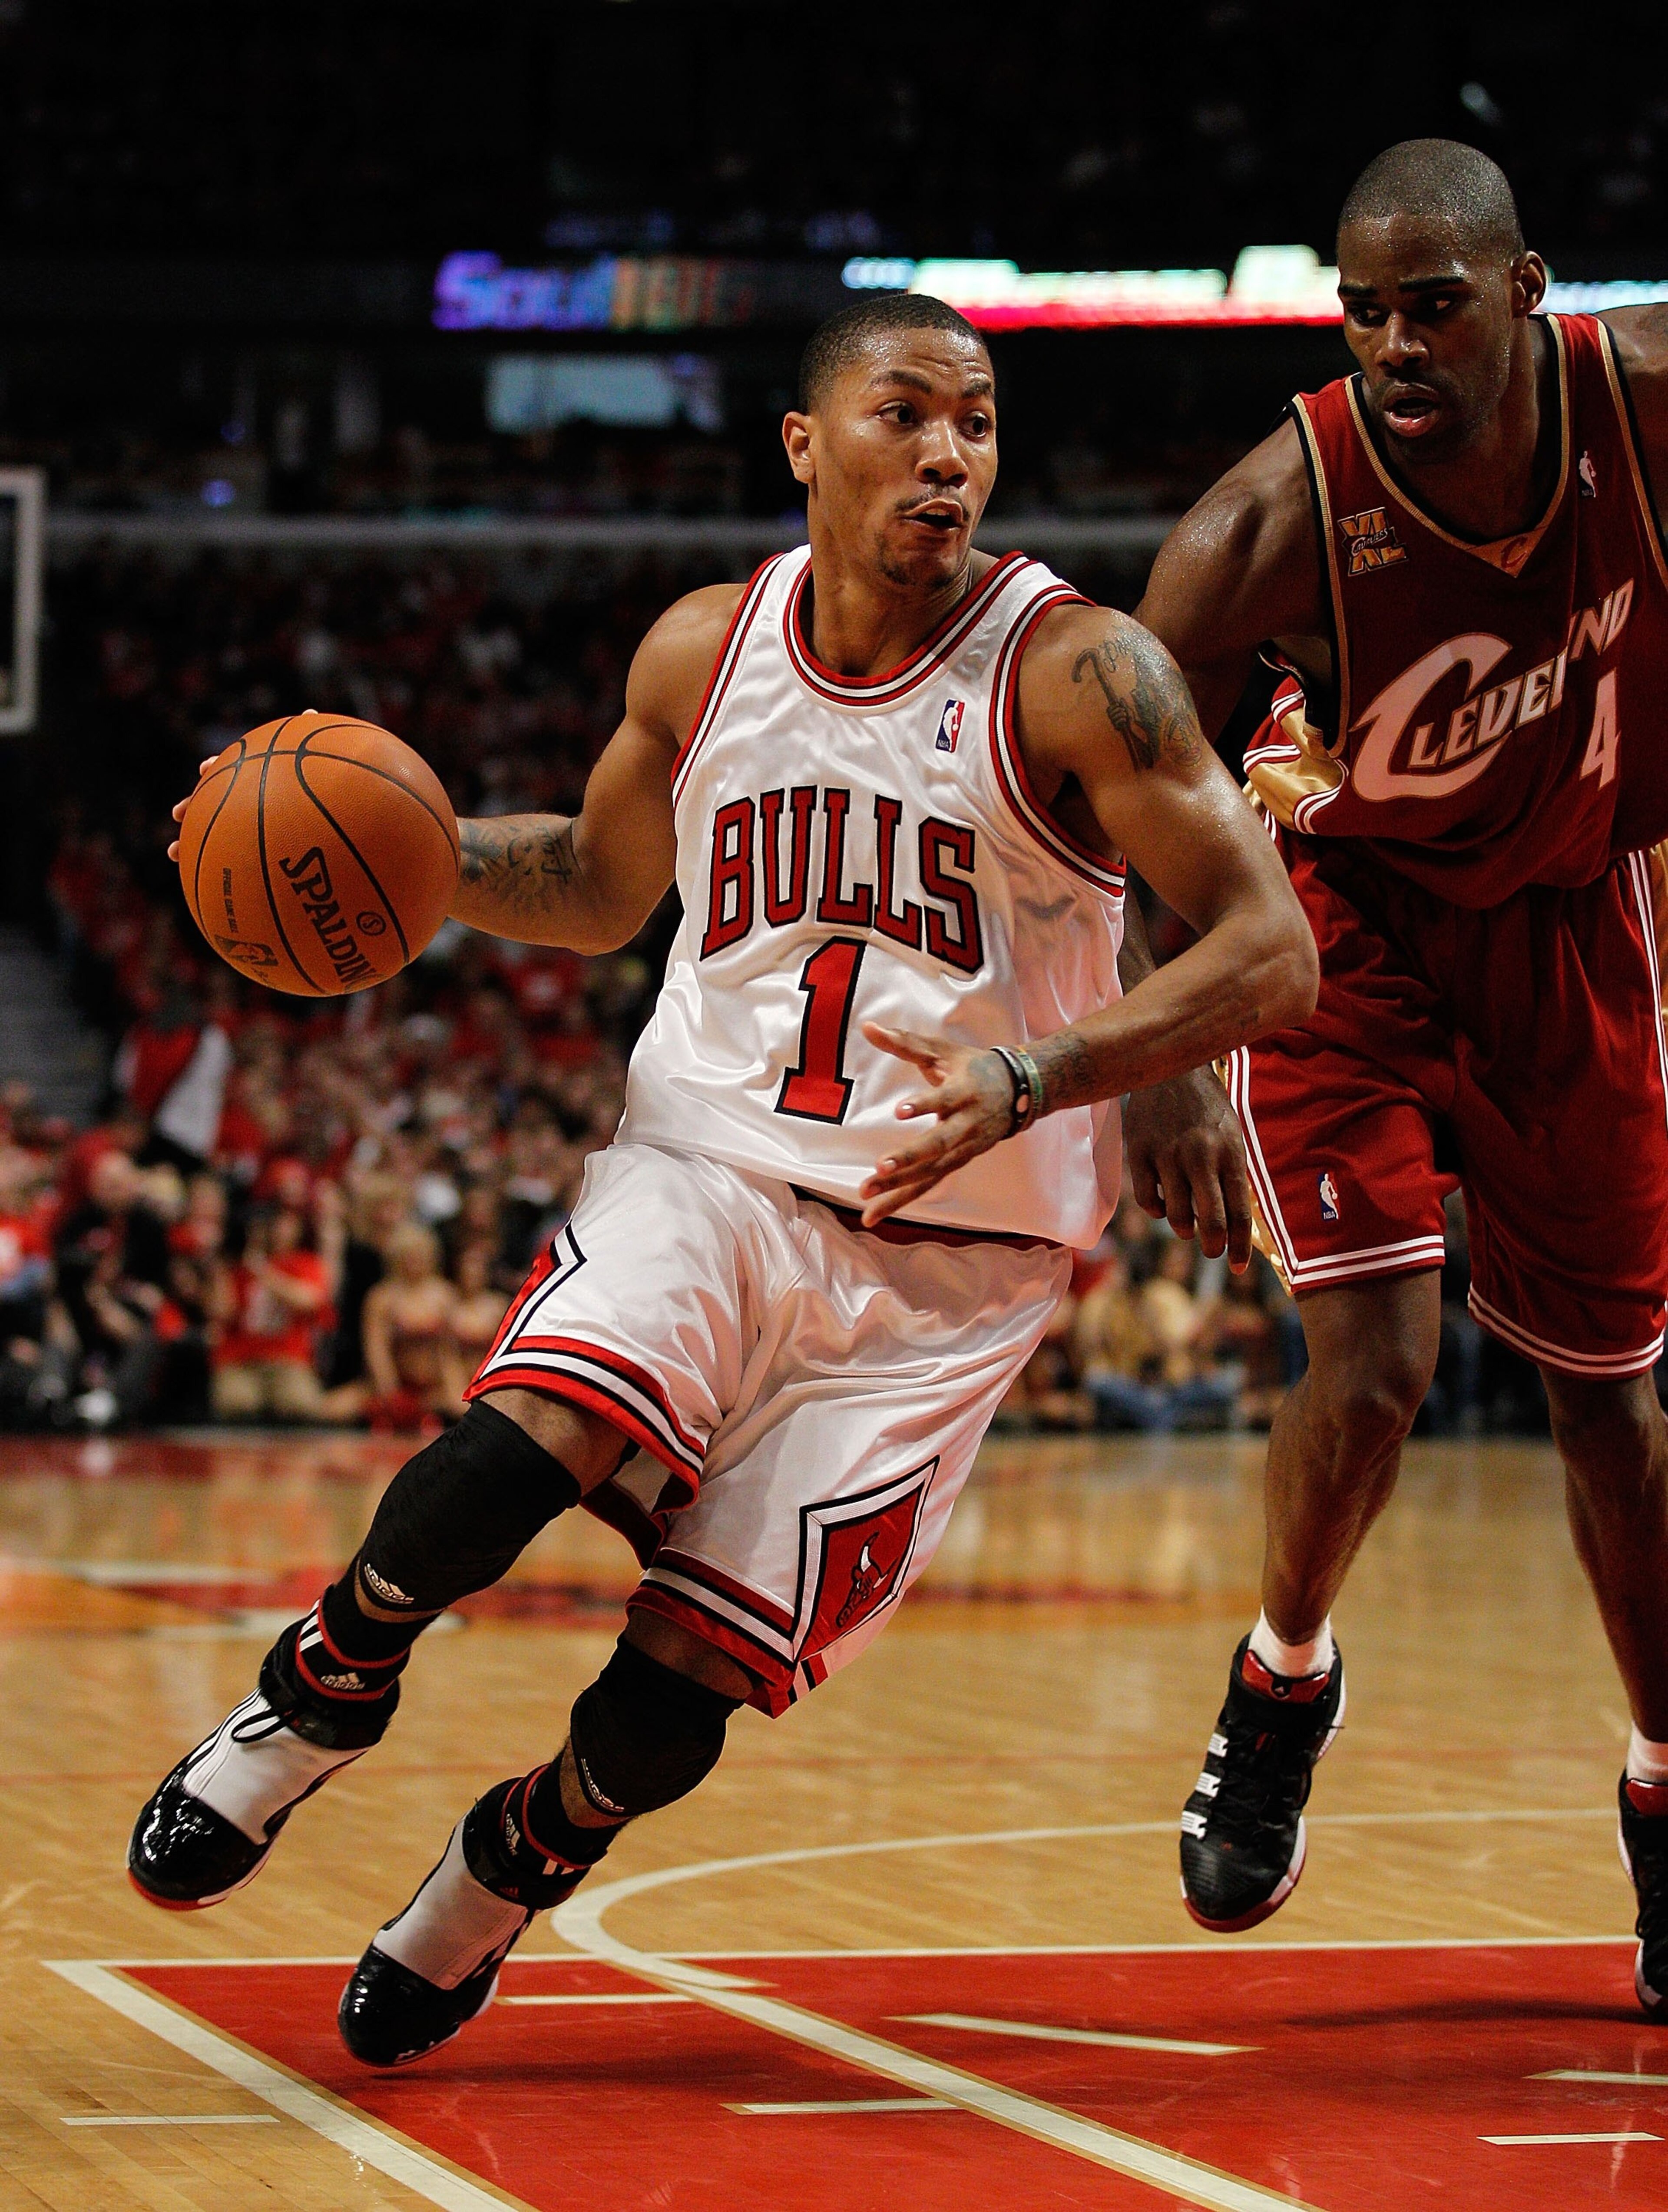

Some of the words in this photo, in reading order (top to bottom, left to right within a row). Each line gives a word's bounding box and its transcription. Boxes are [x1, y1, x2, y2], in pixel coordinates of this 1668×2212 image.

[937, 739, 949, 748] NBA
[1348, 577, 1635, 803] CLEVEND
[1579, 666, 1620, 792] 4
[700, 785, 984, 974] BULLS
[774, 936, 867, 1126] 1
[1323, 1210, 1335, 1220] NBA
[321, 1676, 366, 1690] adidas
